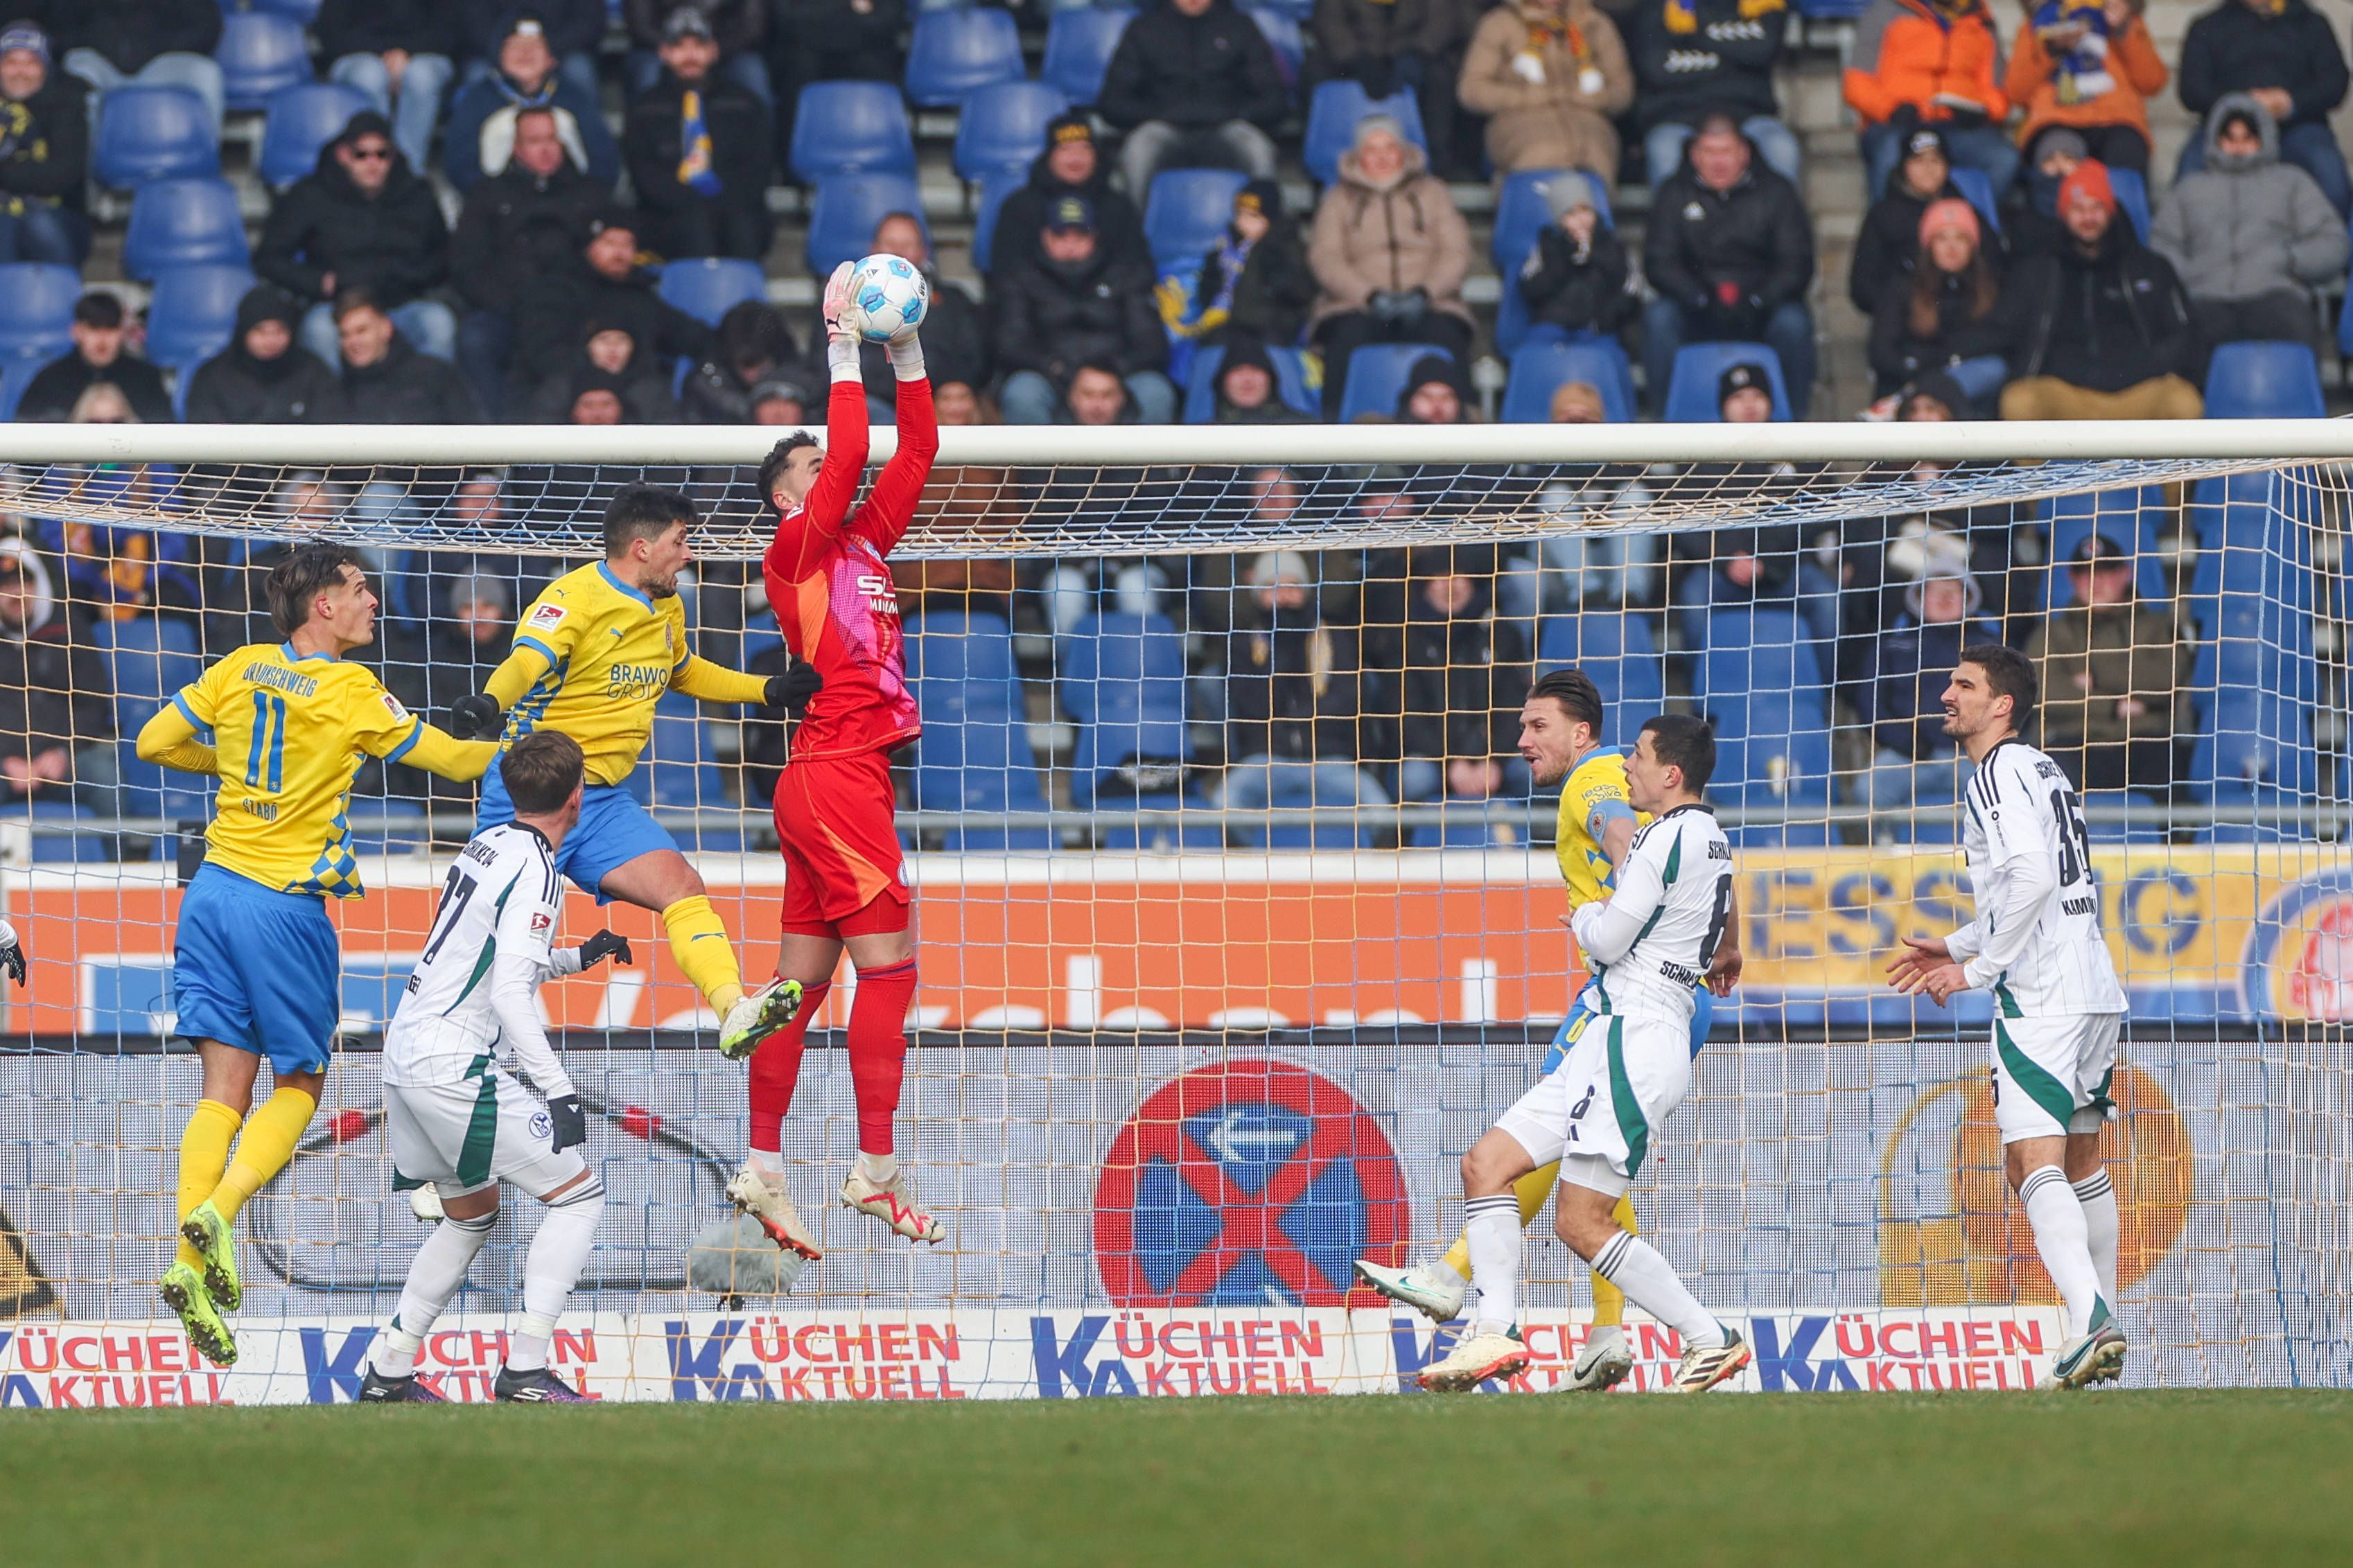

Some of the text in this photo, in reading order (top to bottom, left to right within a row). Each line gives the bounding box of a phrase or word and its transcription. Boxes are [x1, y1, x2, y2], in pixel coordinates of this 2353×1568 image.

[611, 664, 667, 686] BRAWO
[245, 690, 285, 793] 11
[2049, 789, 2093, 888] 35
[0, 1328, 231, 1373] ÜCHE
